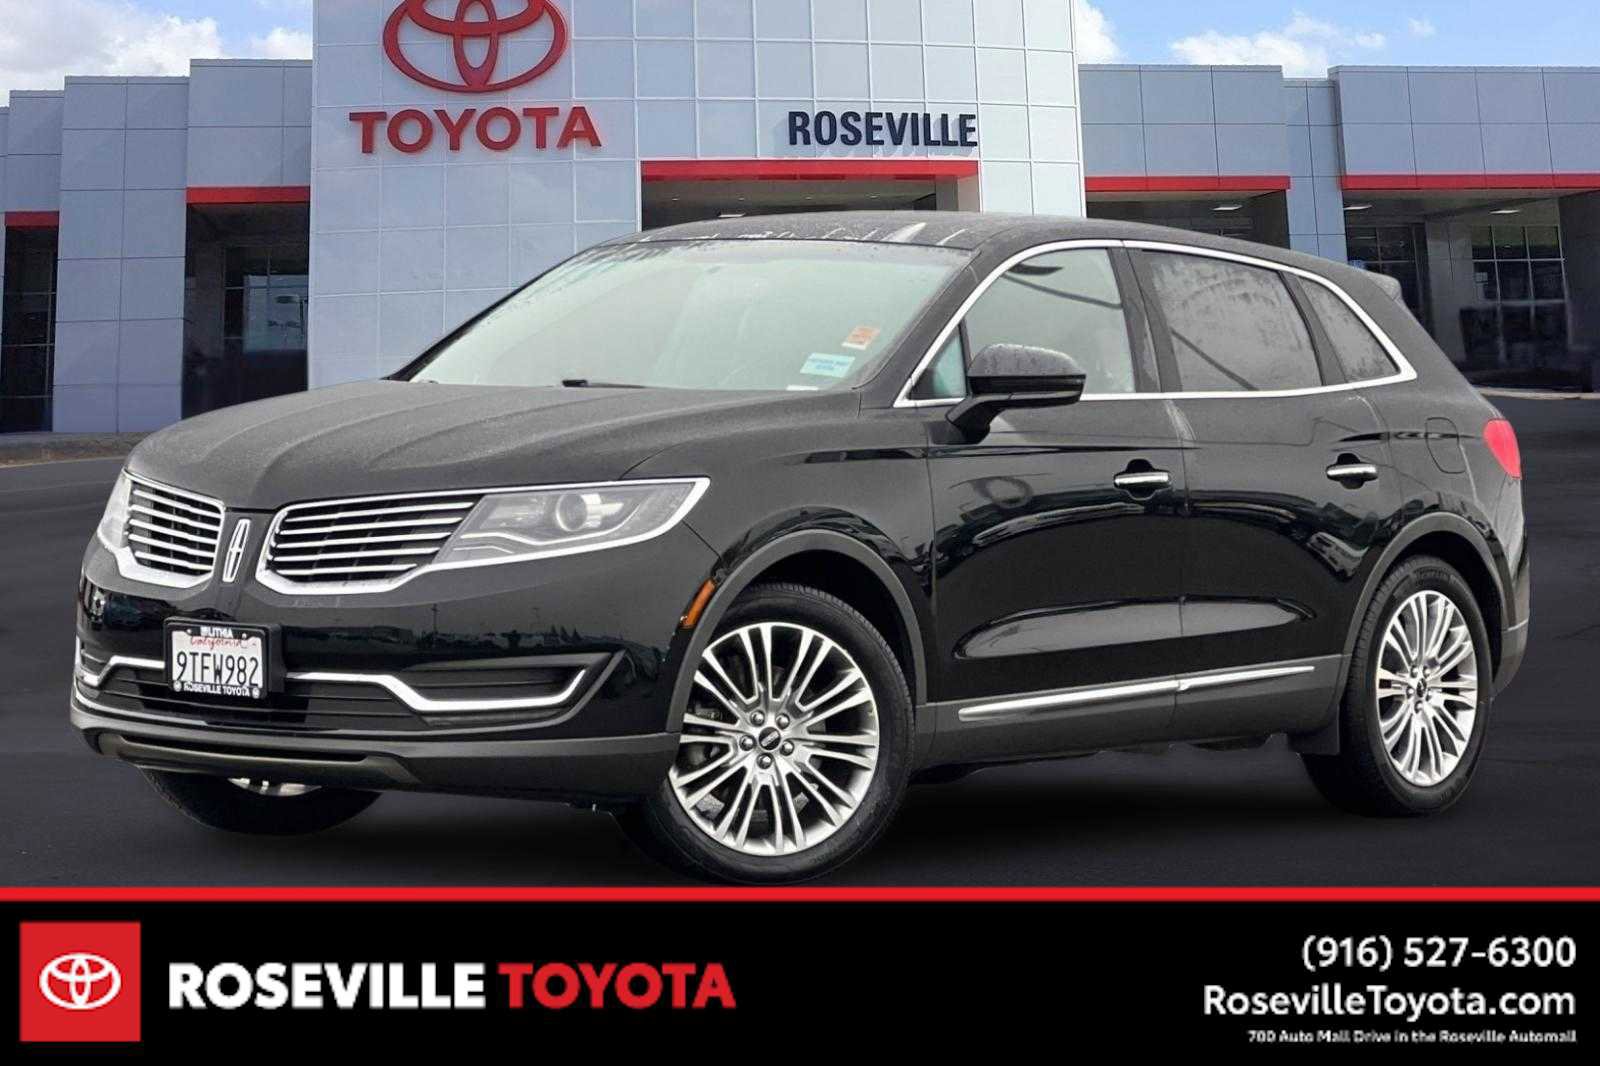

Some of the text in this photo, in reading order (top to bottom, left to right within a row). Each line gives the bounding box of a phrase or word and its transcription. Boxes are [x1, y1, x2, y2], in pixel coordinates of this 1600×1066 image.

[349, 106, 602, 154] TOYOTA
[789, 111, 978, 147] ROSEVILLE
[176, 651, 259, 686] 9TFW982
[184, 682, 250, 697] ROSEVILLE TOYOTA
